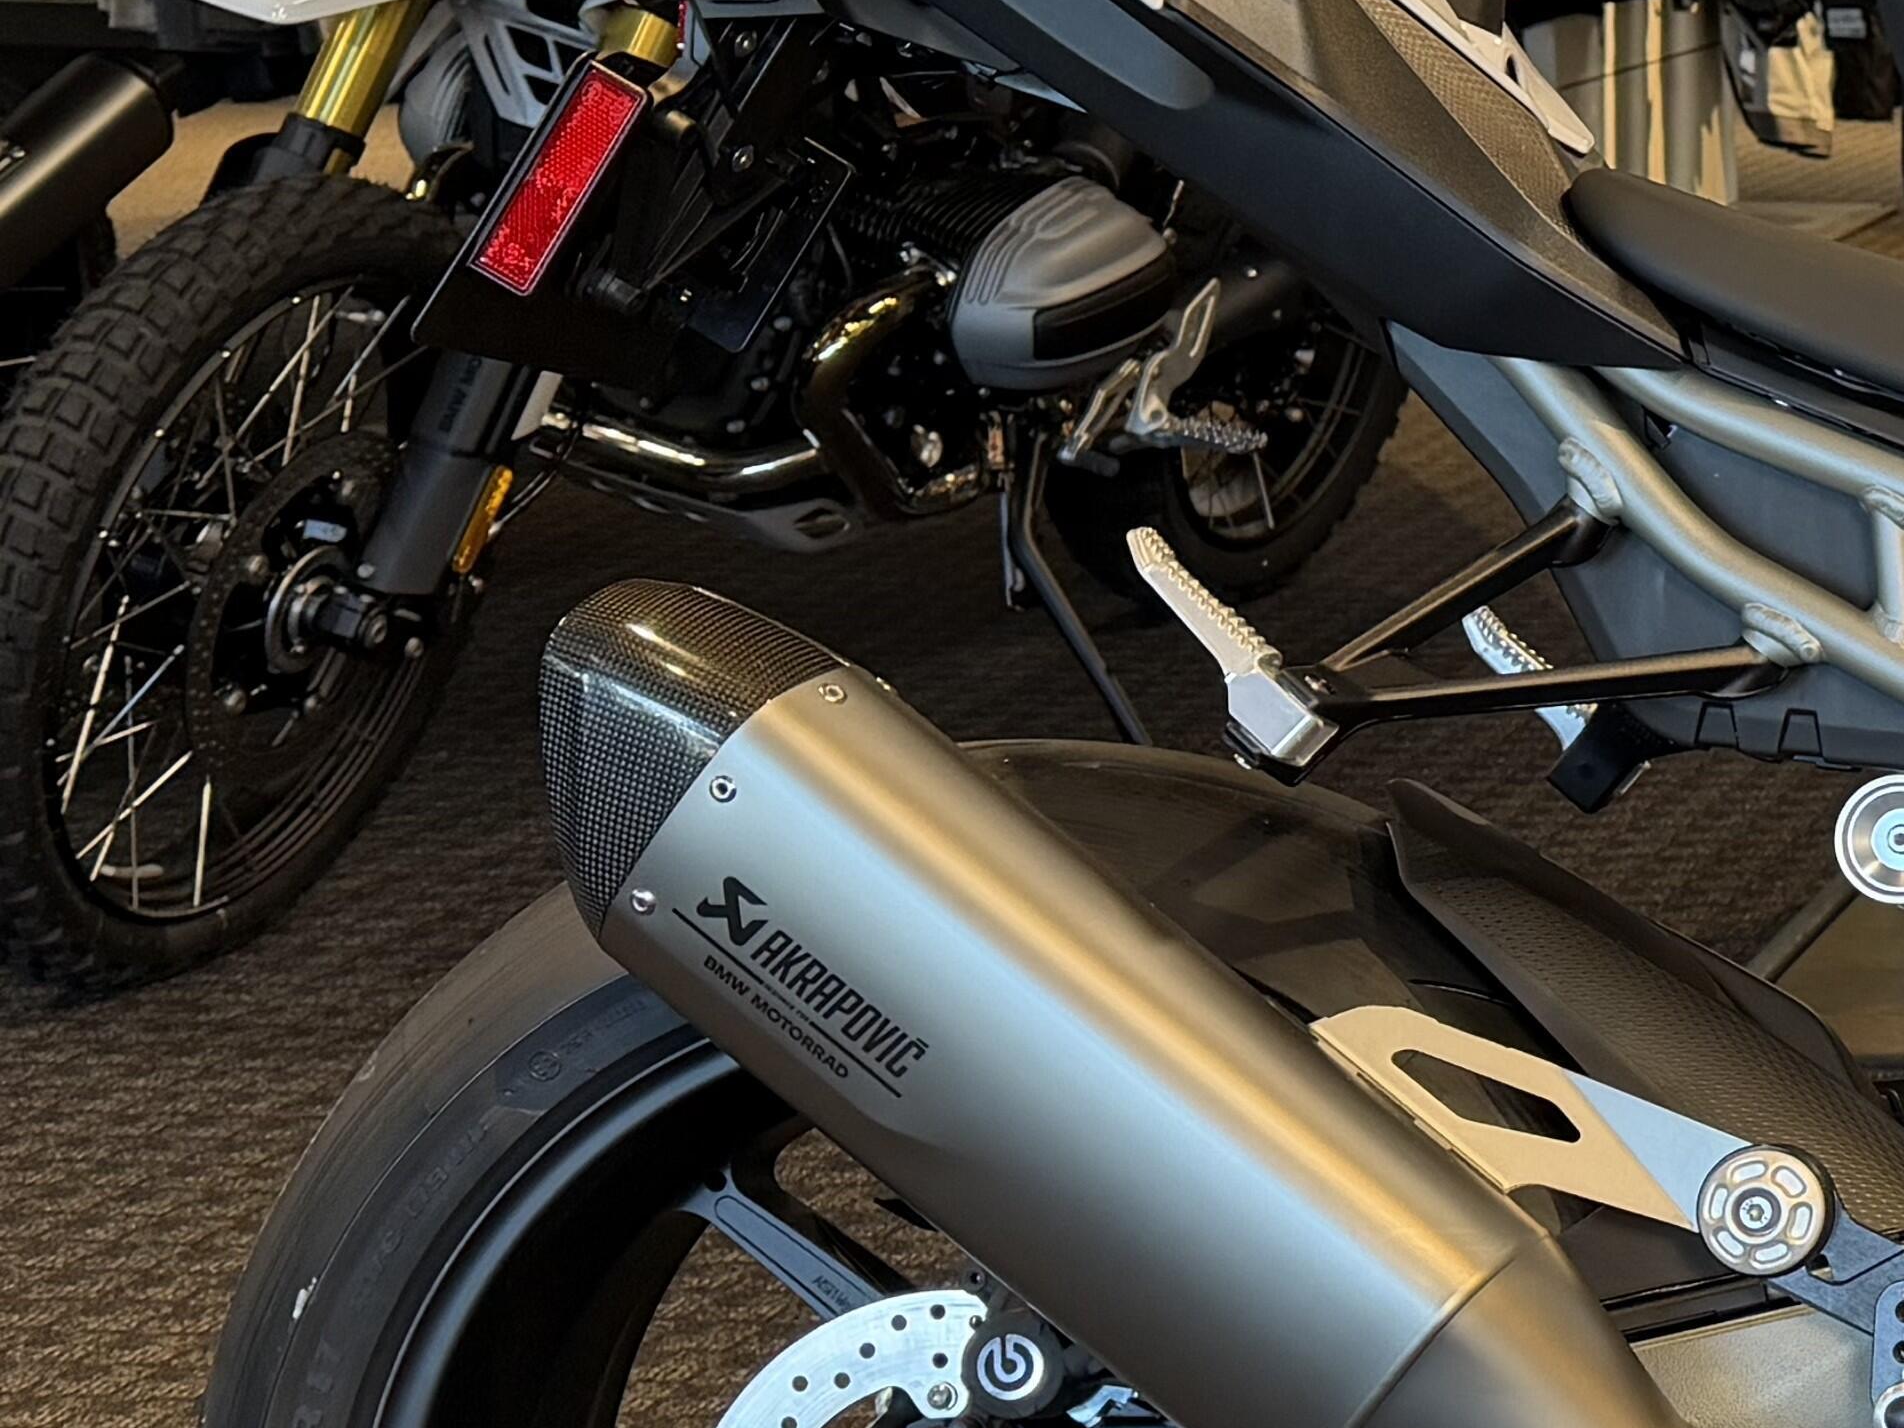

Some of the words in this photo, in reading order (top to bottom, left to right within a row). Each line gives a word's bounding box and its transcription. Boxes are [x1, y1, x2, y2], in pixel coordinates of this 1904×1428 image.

[702, 954, 749, 999] BMW
[751, 991, 851, 1082] MOTORRAD
[751, 928, 930, 1079] AKRAPOVIČ
